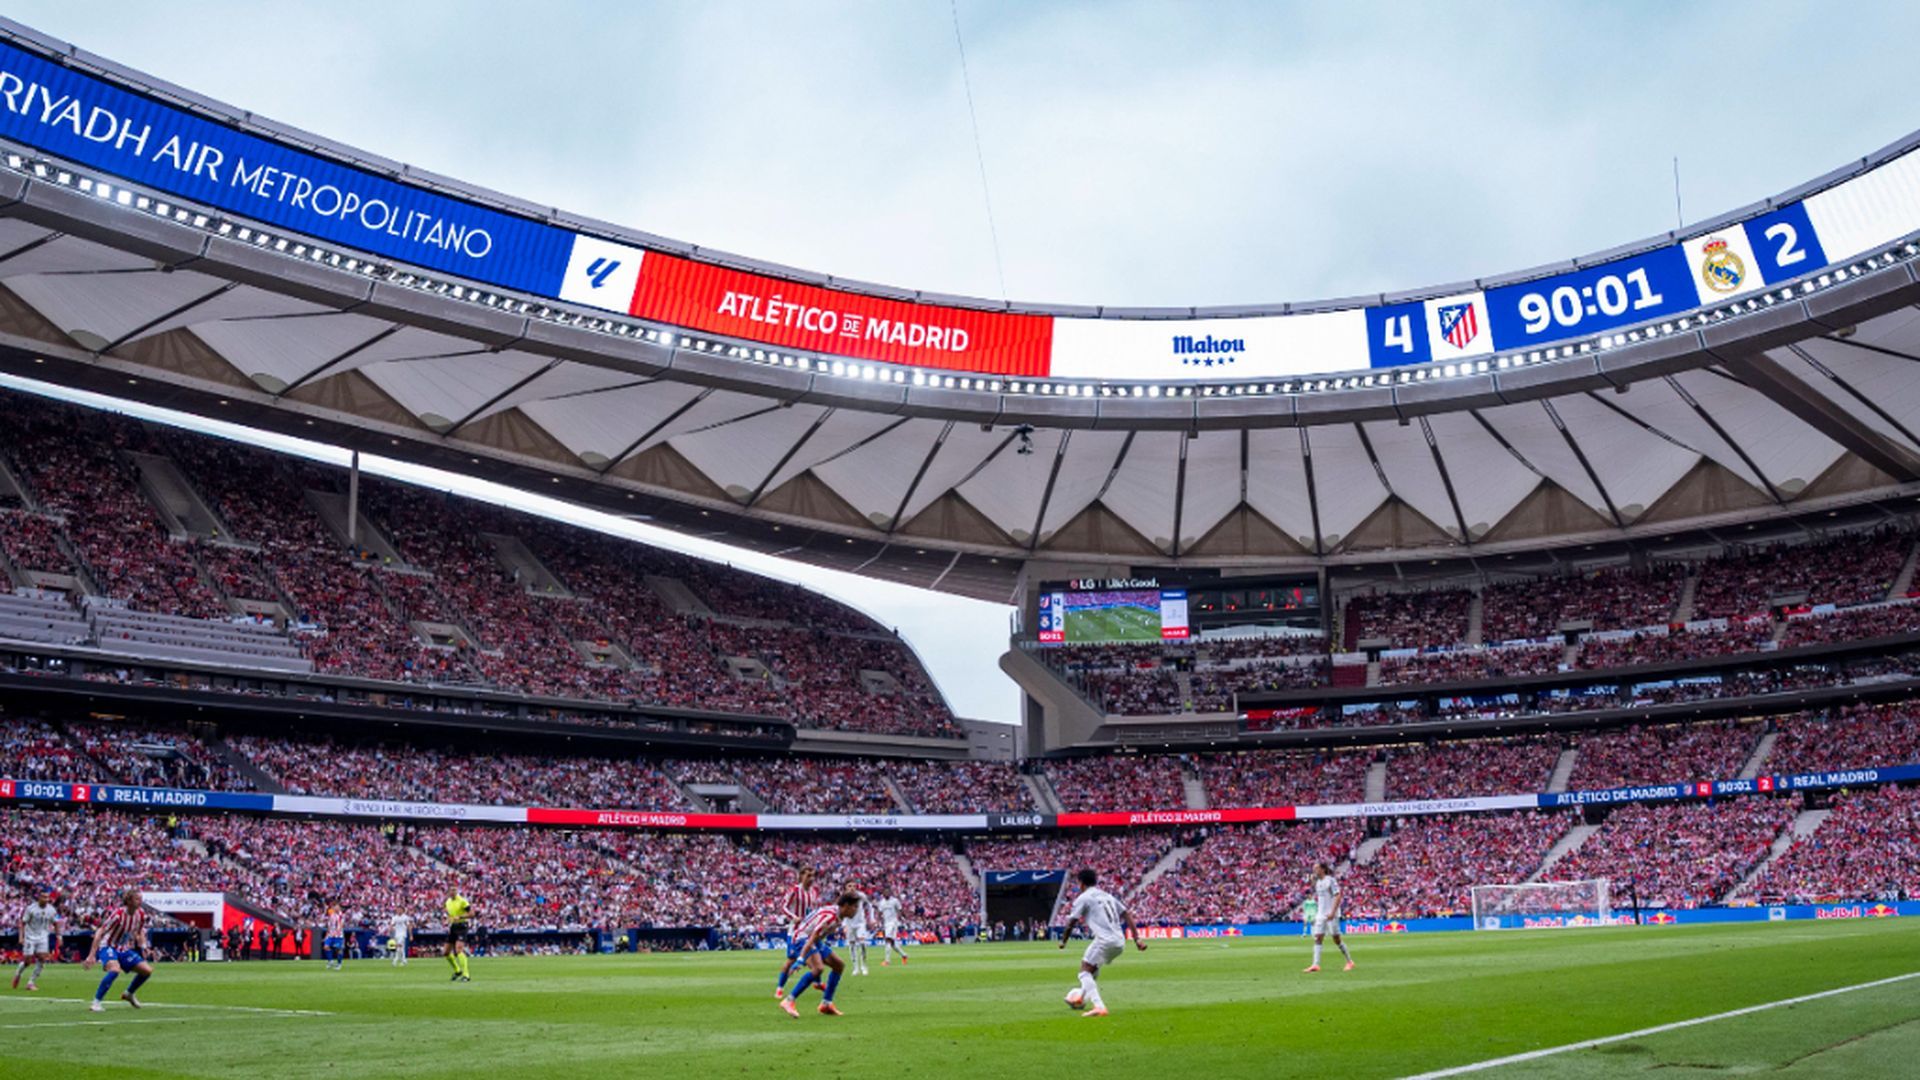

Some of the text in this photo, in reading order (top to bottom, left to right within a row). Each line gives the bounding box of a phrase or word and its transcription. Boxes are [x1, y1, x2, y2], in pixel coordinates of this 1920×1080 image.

[0, 71, 493, 259] RIYADH AIR METROPOLITANO
[1765, 222, 1807, 268] 2
[1518, 267, 1663, 334] 90:01
[717, 290, 970, 353] ATLÉTICO DE MADRID
[1383, 315, 1413, 354] 4
[1172, 334, 1245, 354] Mahou
[1079, 579, 1095, 589] LG
[1760, 779, 1770, 790] 2
[1793, 770, 1878, 787] REAL MADRID
[1, 783, 10, 795] 4
[23, 784, 64, 798] 90:01
[76, 787, 86, 799] 2
[114, 789, 206, 805] REAL MADRID
[1557, 786, 1677, 805] ATLÉTICO DE MADRID
[598, 811, 639, 824] ATLÉTICO
[649, 814, 687, 826] MADRID
[1183, 812, 1222, 822] MADRID
